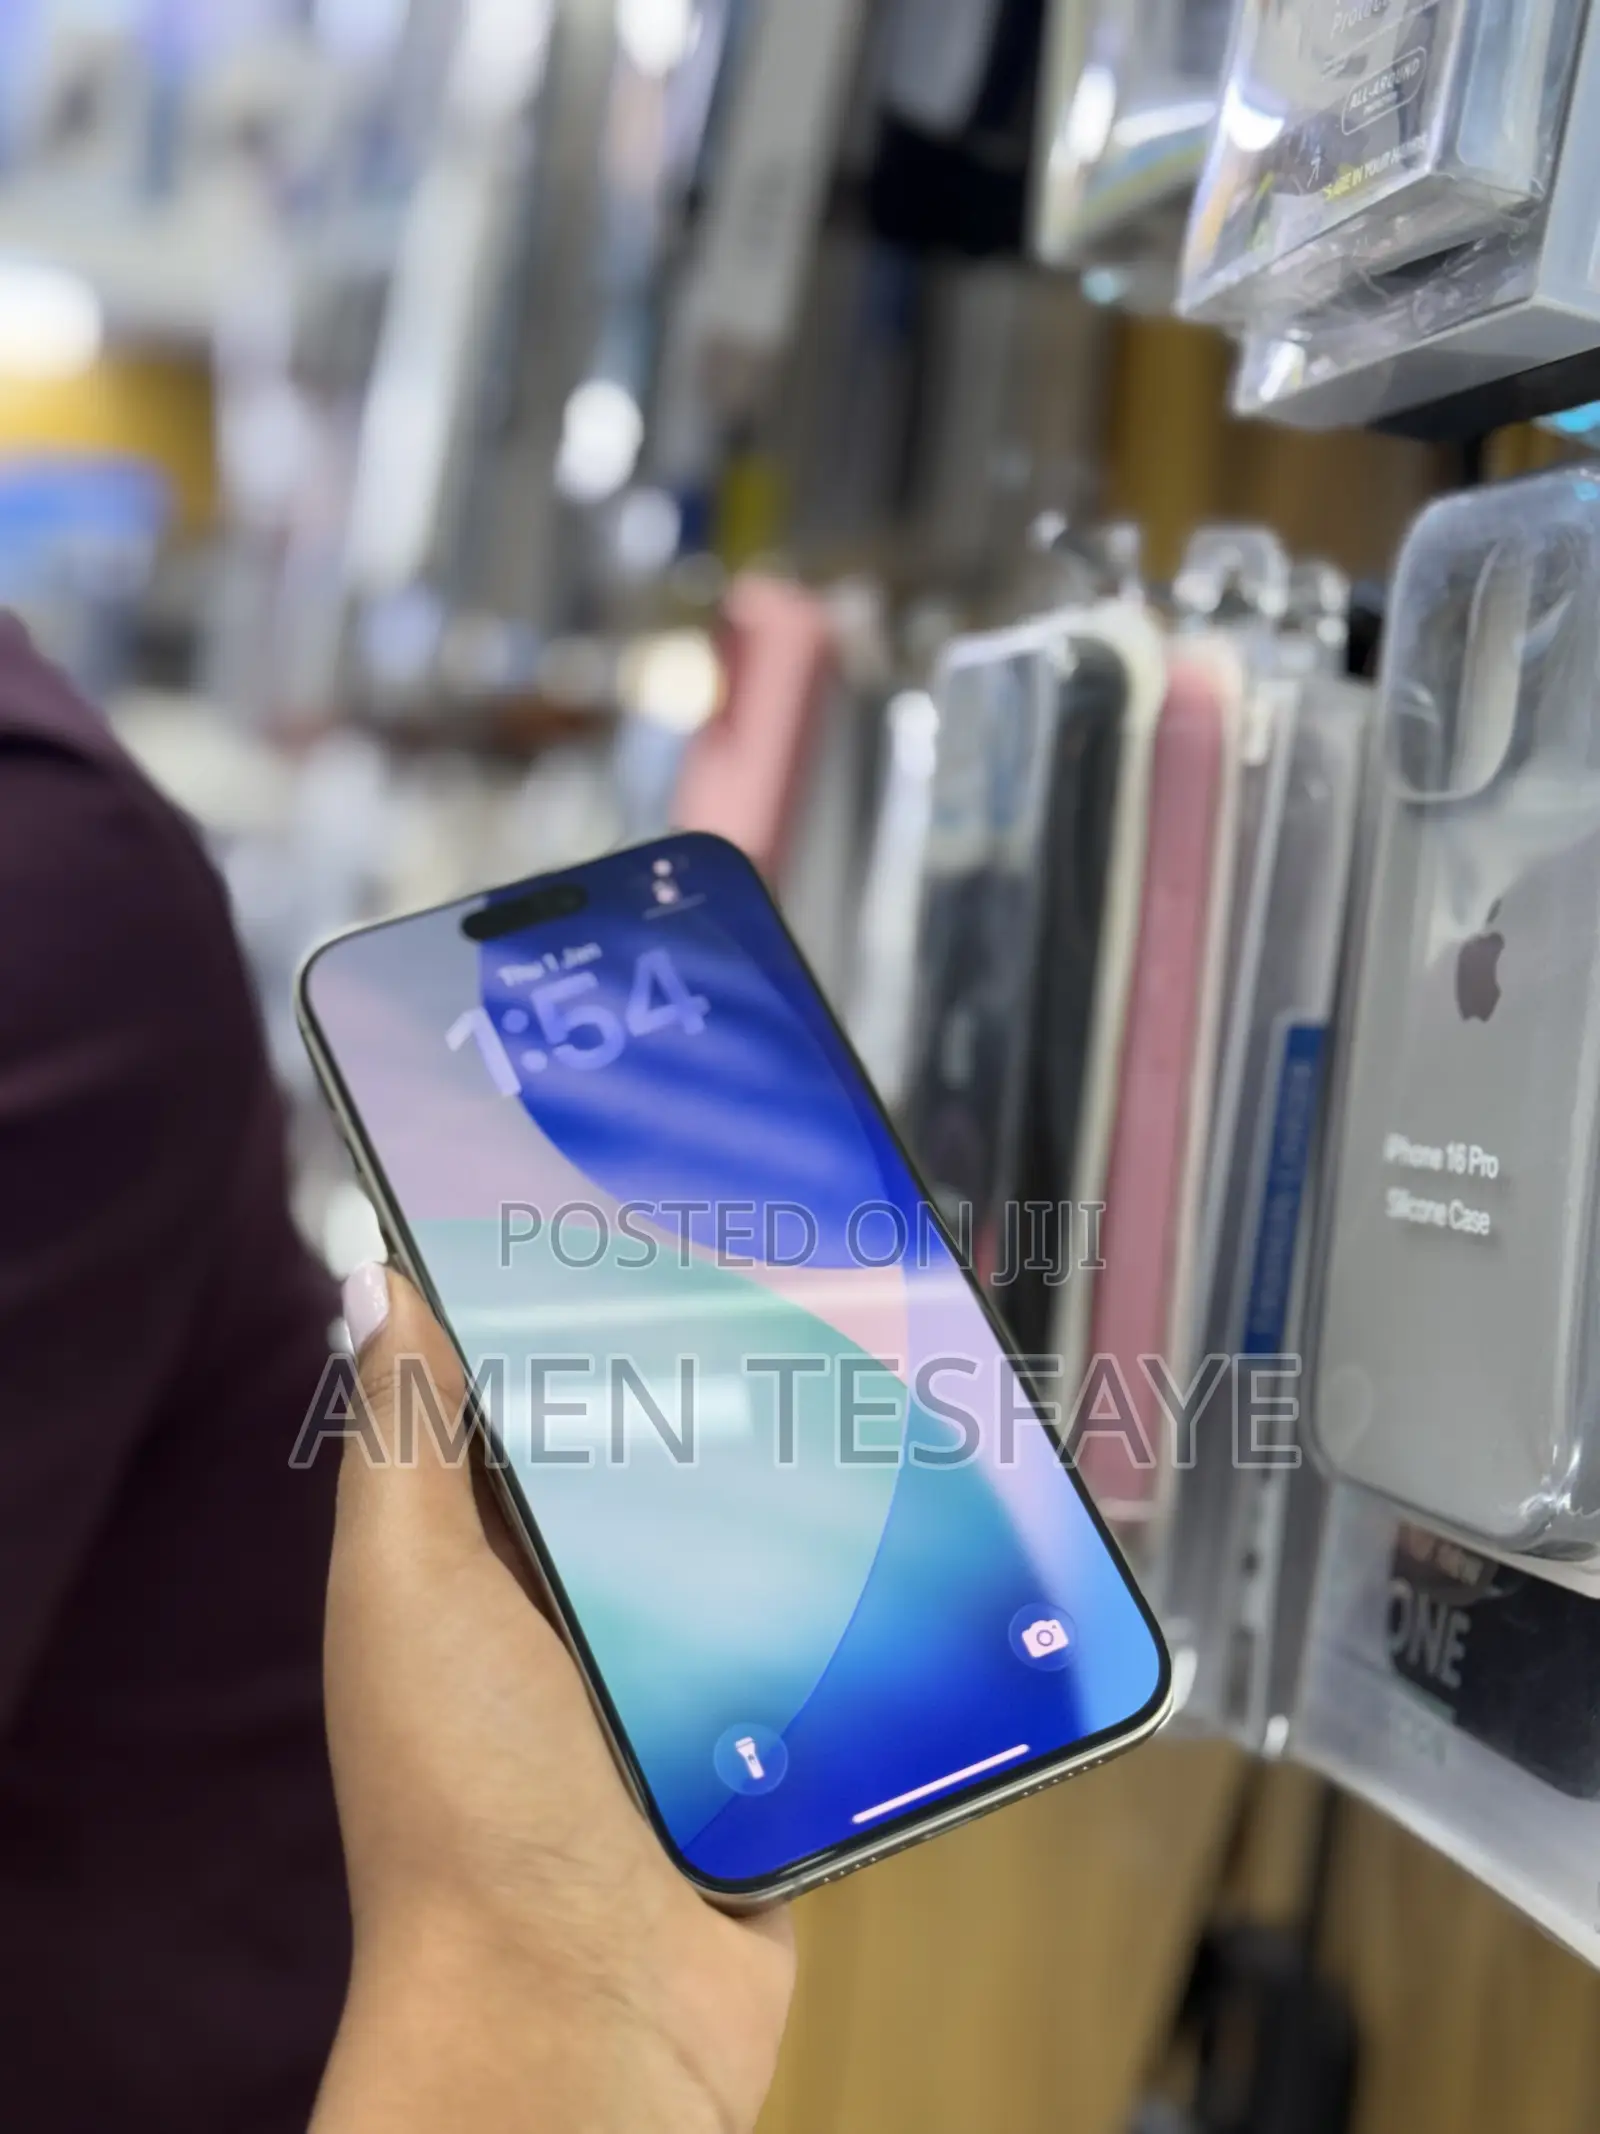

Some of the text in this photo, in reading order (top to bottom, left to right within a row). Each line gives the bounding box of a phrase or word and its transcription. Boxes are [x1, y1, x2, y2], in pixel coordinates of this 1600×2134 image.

[445, 948, 710, 1099] 1:54
[1468, 1145, 1499, 1179] Pro
[1449, 1199, 1491, 1235] Case
